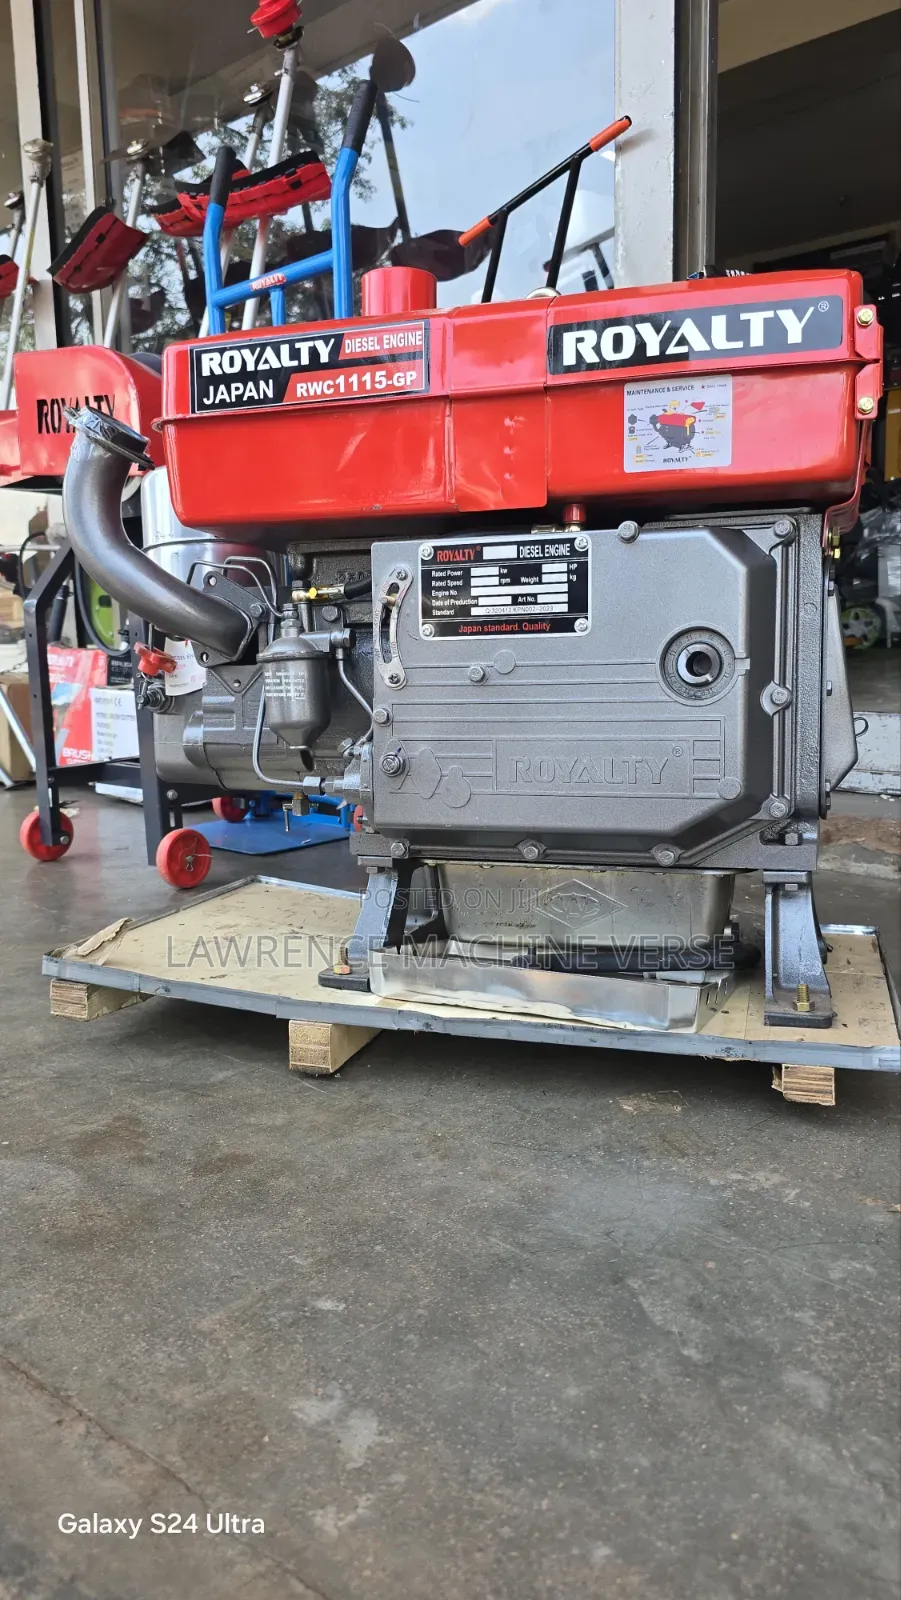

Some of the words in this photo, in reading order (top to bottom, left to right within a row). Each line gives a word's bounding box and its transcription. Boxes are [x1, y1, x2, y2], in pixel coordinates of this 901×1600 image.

[345, 336, 380, 354] DIESEL
[383, 330, 422, 349] ENGINE
[201, 337, 335, 377] ROYALTY
[296, 370, 417, 398] RWC1115-GP
[626, 387, 665, 396] MAINTENANCE
[671, 384, 695, 392] SERVICE
[203, 379, 274, 405] JAPAN
[519, 545, 543, 558] DIESEL
[544, 543, 571, 557] ENGINE
[447, 579, 463, 587] Speed
[520, 576, 539, 584] Weight
[569, 573, 577, 582] kg
[431, 590, 449, 598] Engine
[431, 599, 443, 607] Date
[444, 598, 449, 606] of
[450, 598, 478, 606] Production
[459, 624, 482, 634] Japan
[483, 622, 520, 632] standard.
[522, 621, 551, 631] Quality
